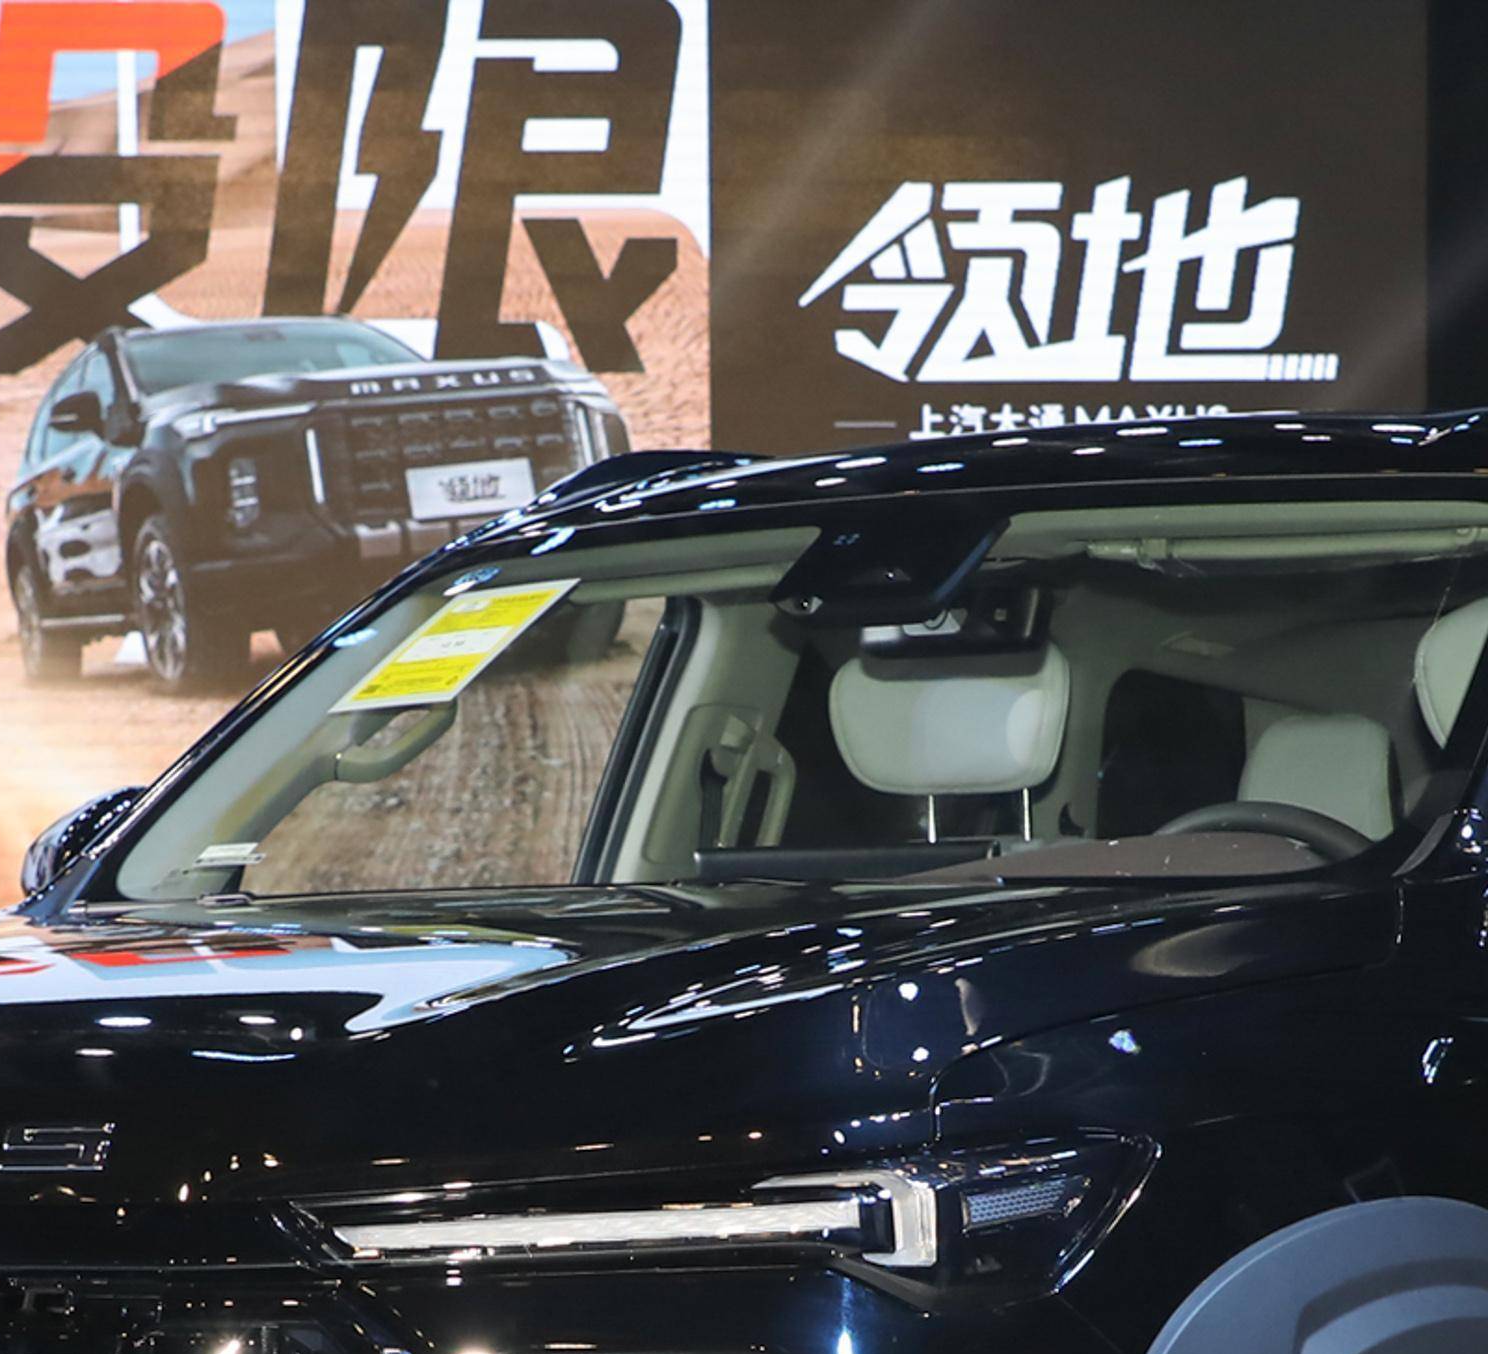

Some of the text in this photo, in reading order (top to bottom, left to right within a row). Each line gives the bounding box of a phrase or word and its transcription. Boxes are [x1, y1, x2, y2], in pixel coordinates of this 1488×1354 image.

[798, 175, 1339, 382] 领地
[350, 370, 535, 395] MAXUS
[909, 402, 1065, 439] 上汽大通
